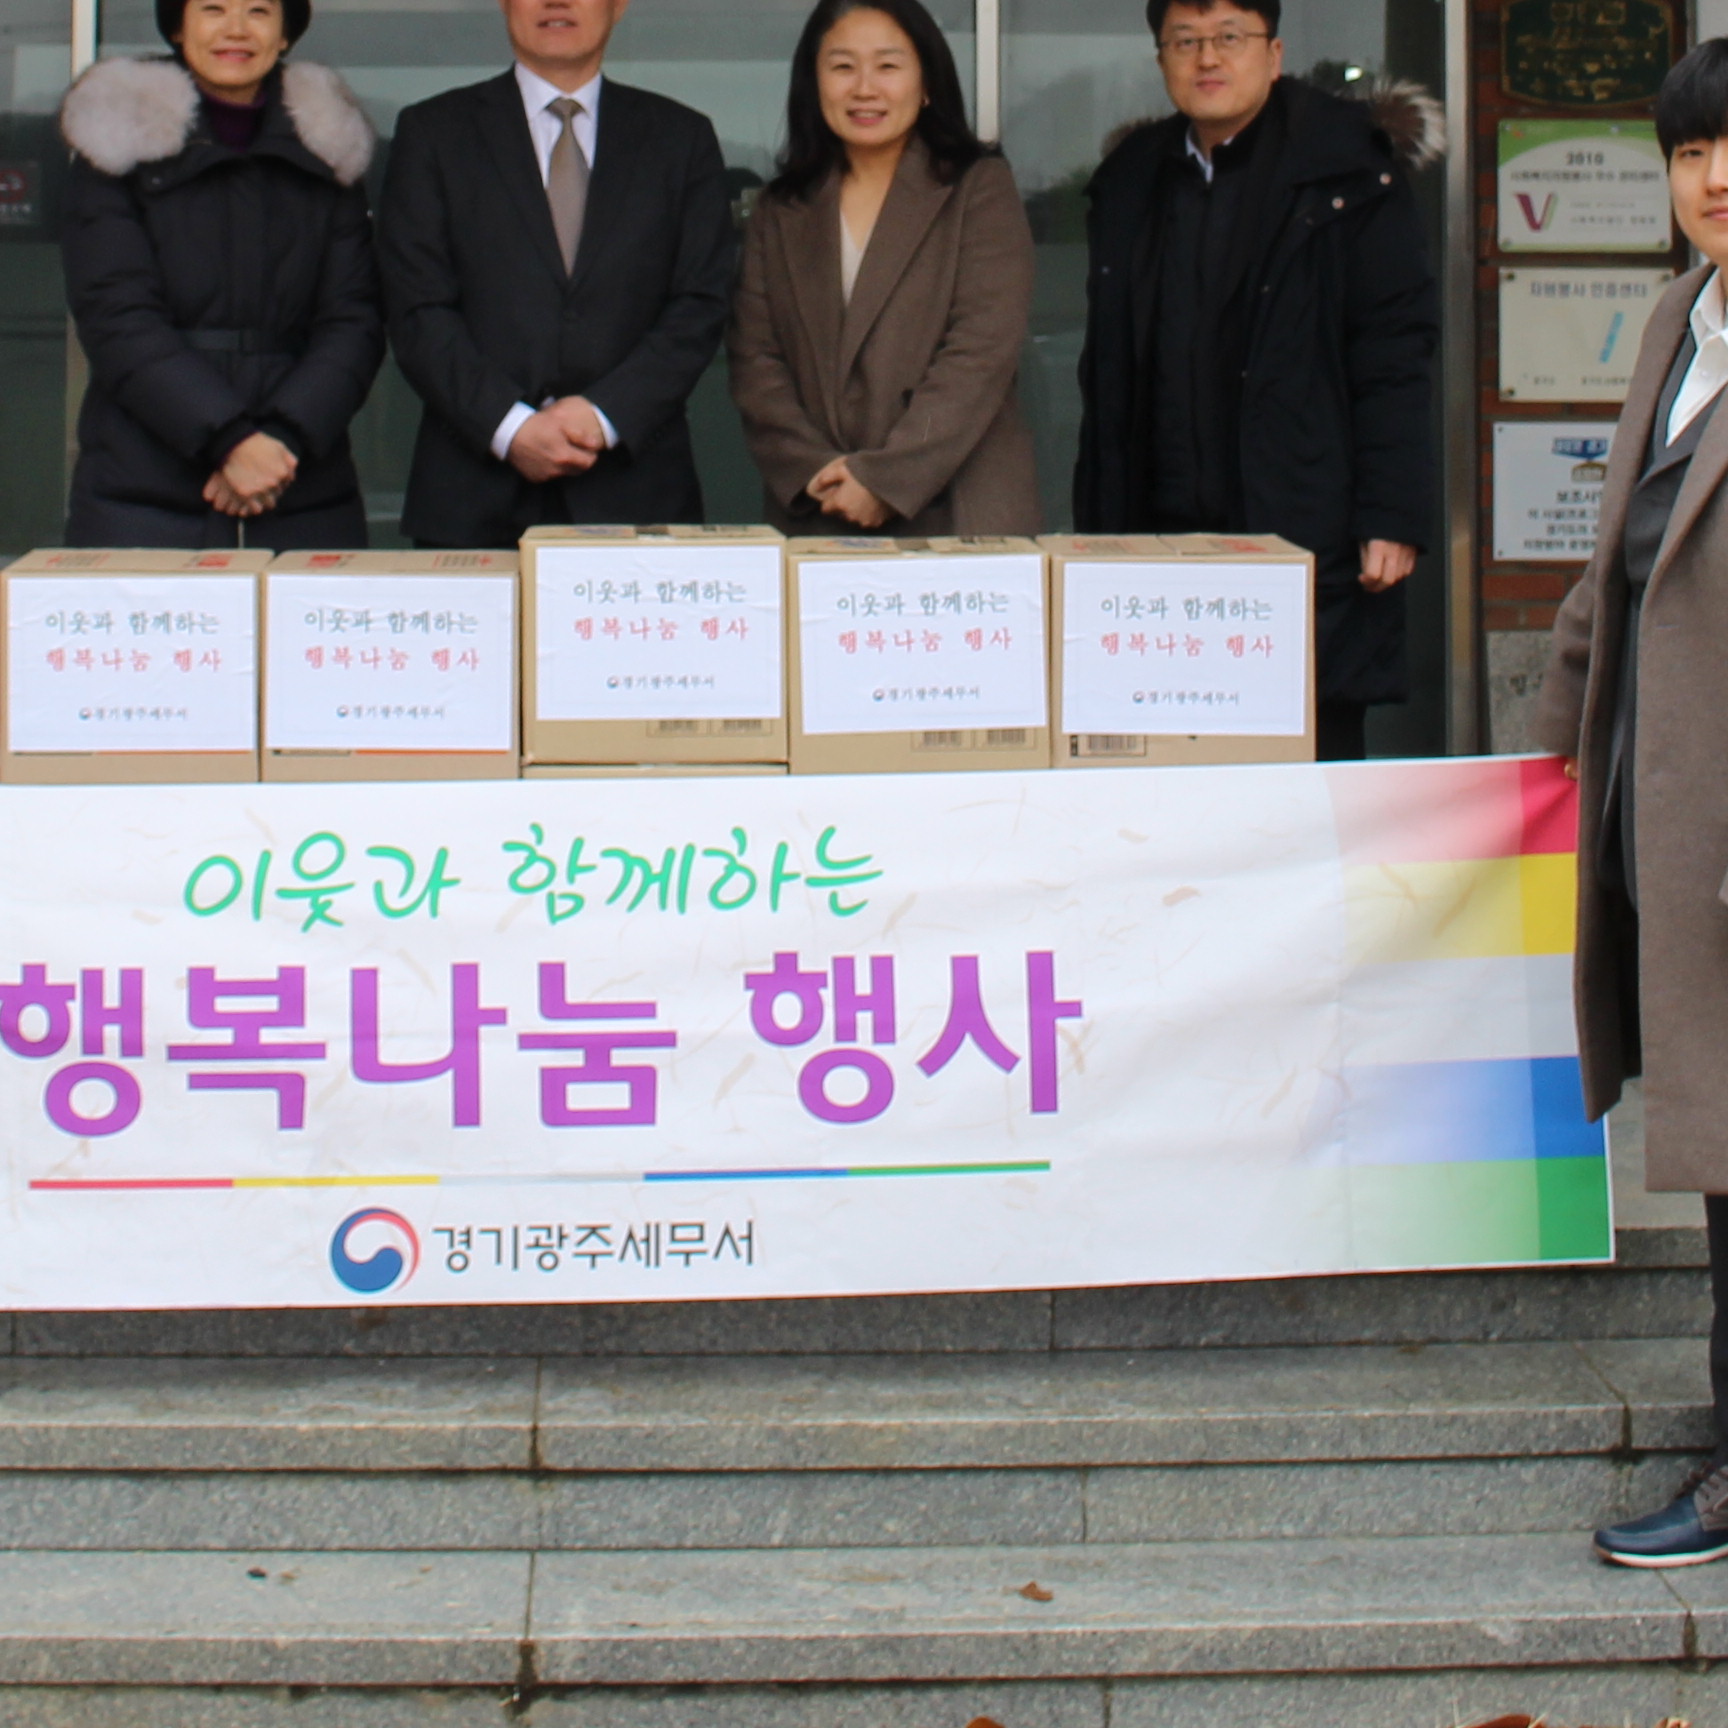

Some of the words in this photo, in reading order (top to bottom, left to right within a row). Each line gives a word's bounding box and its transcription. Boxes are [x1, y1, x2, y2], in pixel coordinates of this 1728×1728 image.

[573, 580, 641, 604] 이웃과
[656, 580, 746, 604] 함께하는
[836, 593, 905, 617] 이웃과
[919, 591, 1009, 617] 함께하는
[1100, 595, 1169, 620] 이웃과
[1183, 597, 1272, 621] 함께하는
[45, 611, 113, 635] 이웃과
[128, 612, 217, 636] 함께하는
[304, 609, 373, 633] 이웃과
[386, 611, 477, 635] 함께하는
[574, 617, 677, 641] 행복나눔
[700, 617, 748, 641] 행사
[838, 629, 941, 654] 행복나눔
[964, 627, 1011, 651] 행사
[1101, 632, 1204, 657] 행복나눔
[1226, 634, 1273, 658] 행사
[46, 647, 150, 672] 행복나눔
[173, 648, 221, 673] 행사
[305, 646, 408, 671] 행복나눔
[431, 648, 479, 671] 행사
[184, 832, 460, 933] 이웃과
[502, 824, 883, 925] 함께하는
[745, 951, 1082, 1123] 행사
[434, 1221, 752, 1272] 경기광주세무서
